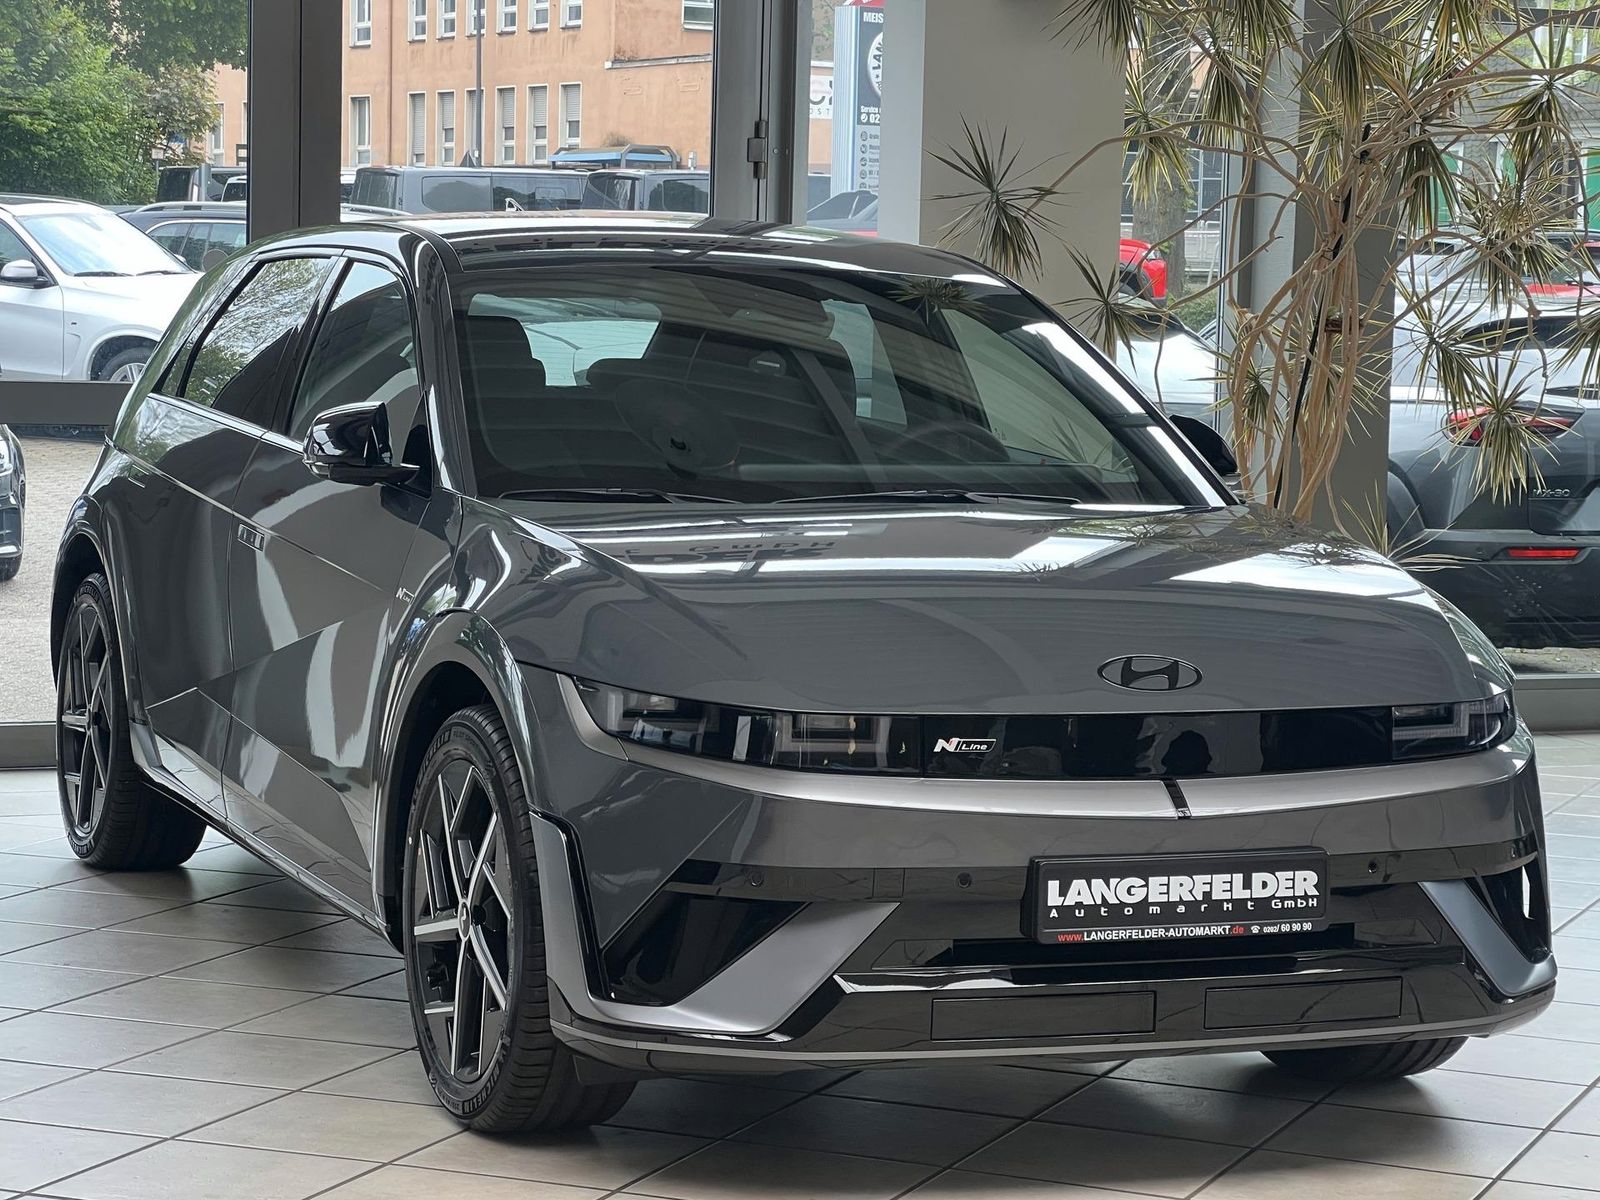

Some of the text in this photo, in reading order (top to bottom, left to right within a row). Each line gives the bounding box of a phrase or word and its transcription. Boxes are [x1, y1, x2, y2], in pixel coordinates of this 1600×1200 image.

[933, 737, 960, 752] N
[1047, 870, 1320, 907] LANGERFELDER
[1271, 898, 1318, 909] GmbH
[1057, 925, 1245, 942] www.LANGERFELDER-AUTOMARKT.de
[1281, 923, 1291, 932] 60
[1291, 922, 1302, 931] 90
[1302, 921, 1313, 931] 90
